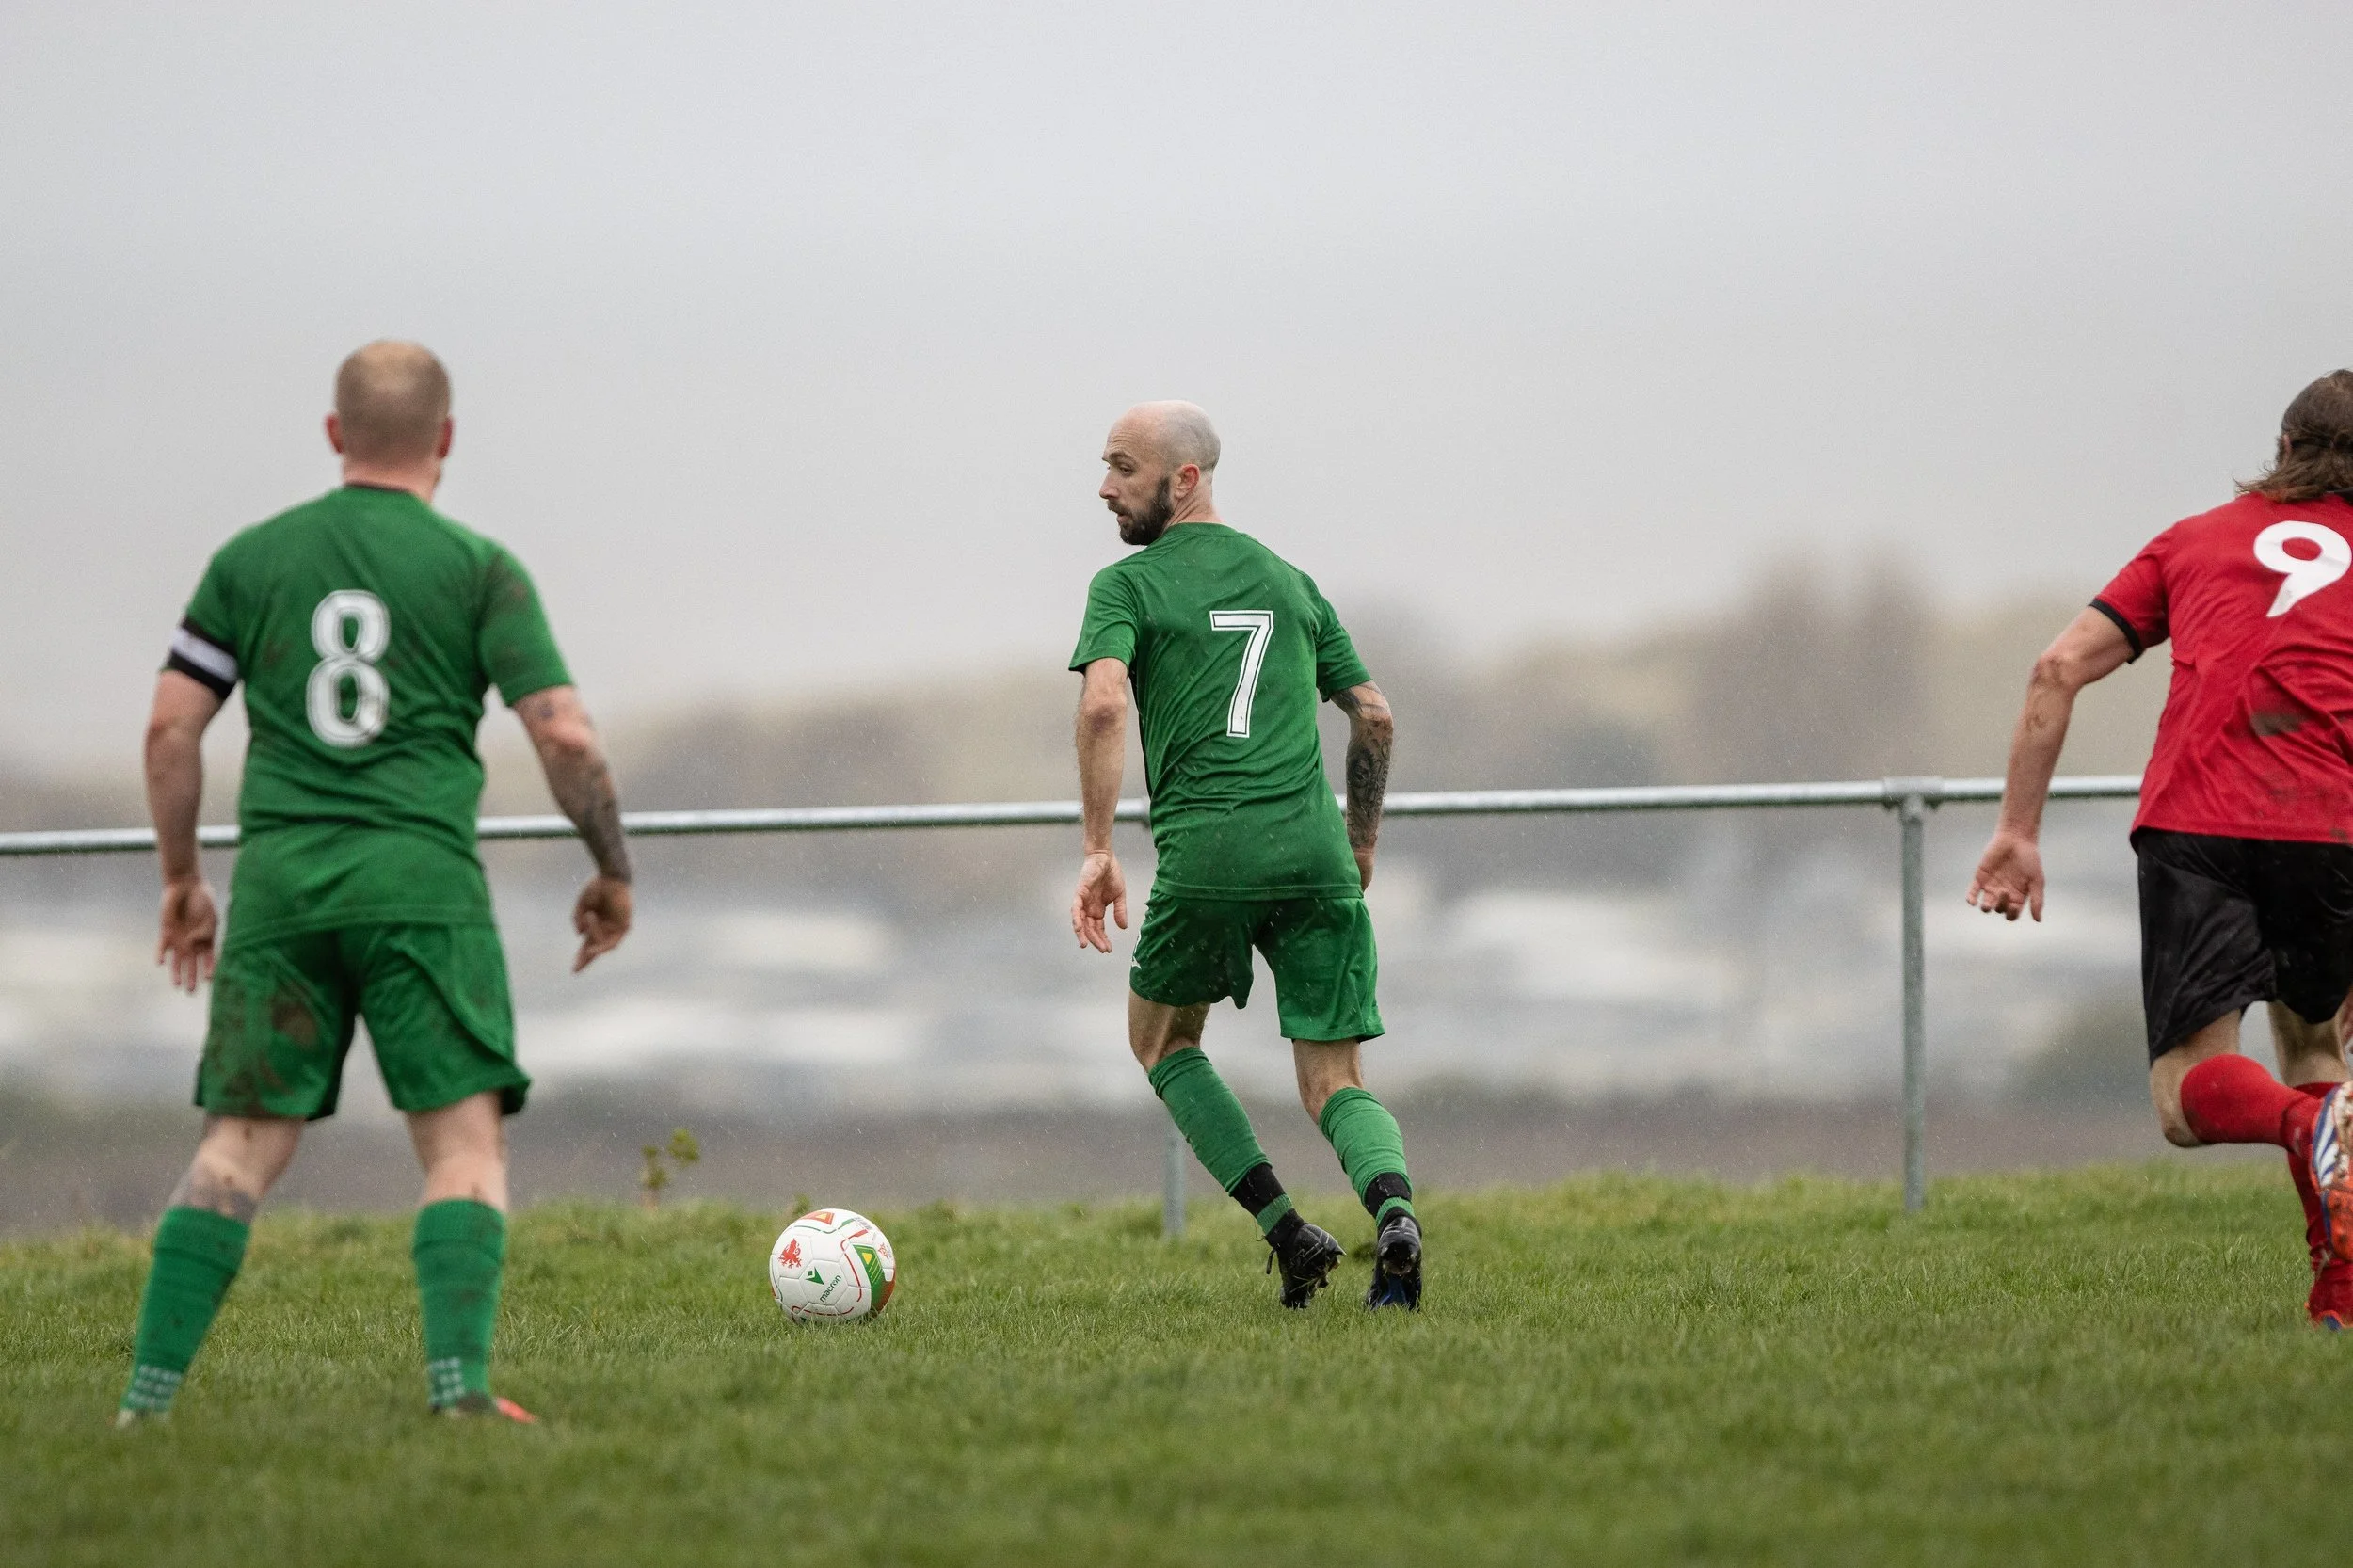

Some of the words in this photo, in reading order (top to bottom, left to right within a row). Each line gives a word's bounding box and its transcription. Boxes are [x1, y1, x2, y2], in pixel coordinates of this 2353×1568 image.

[2253, 520, 2352, 618] 9
[306, 589, 391, 748] 8
[1209, 610, 1273, 738] 7
[819, 1274, 842, 1303] macron
